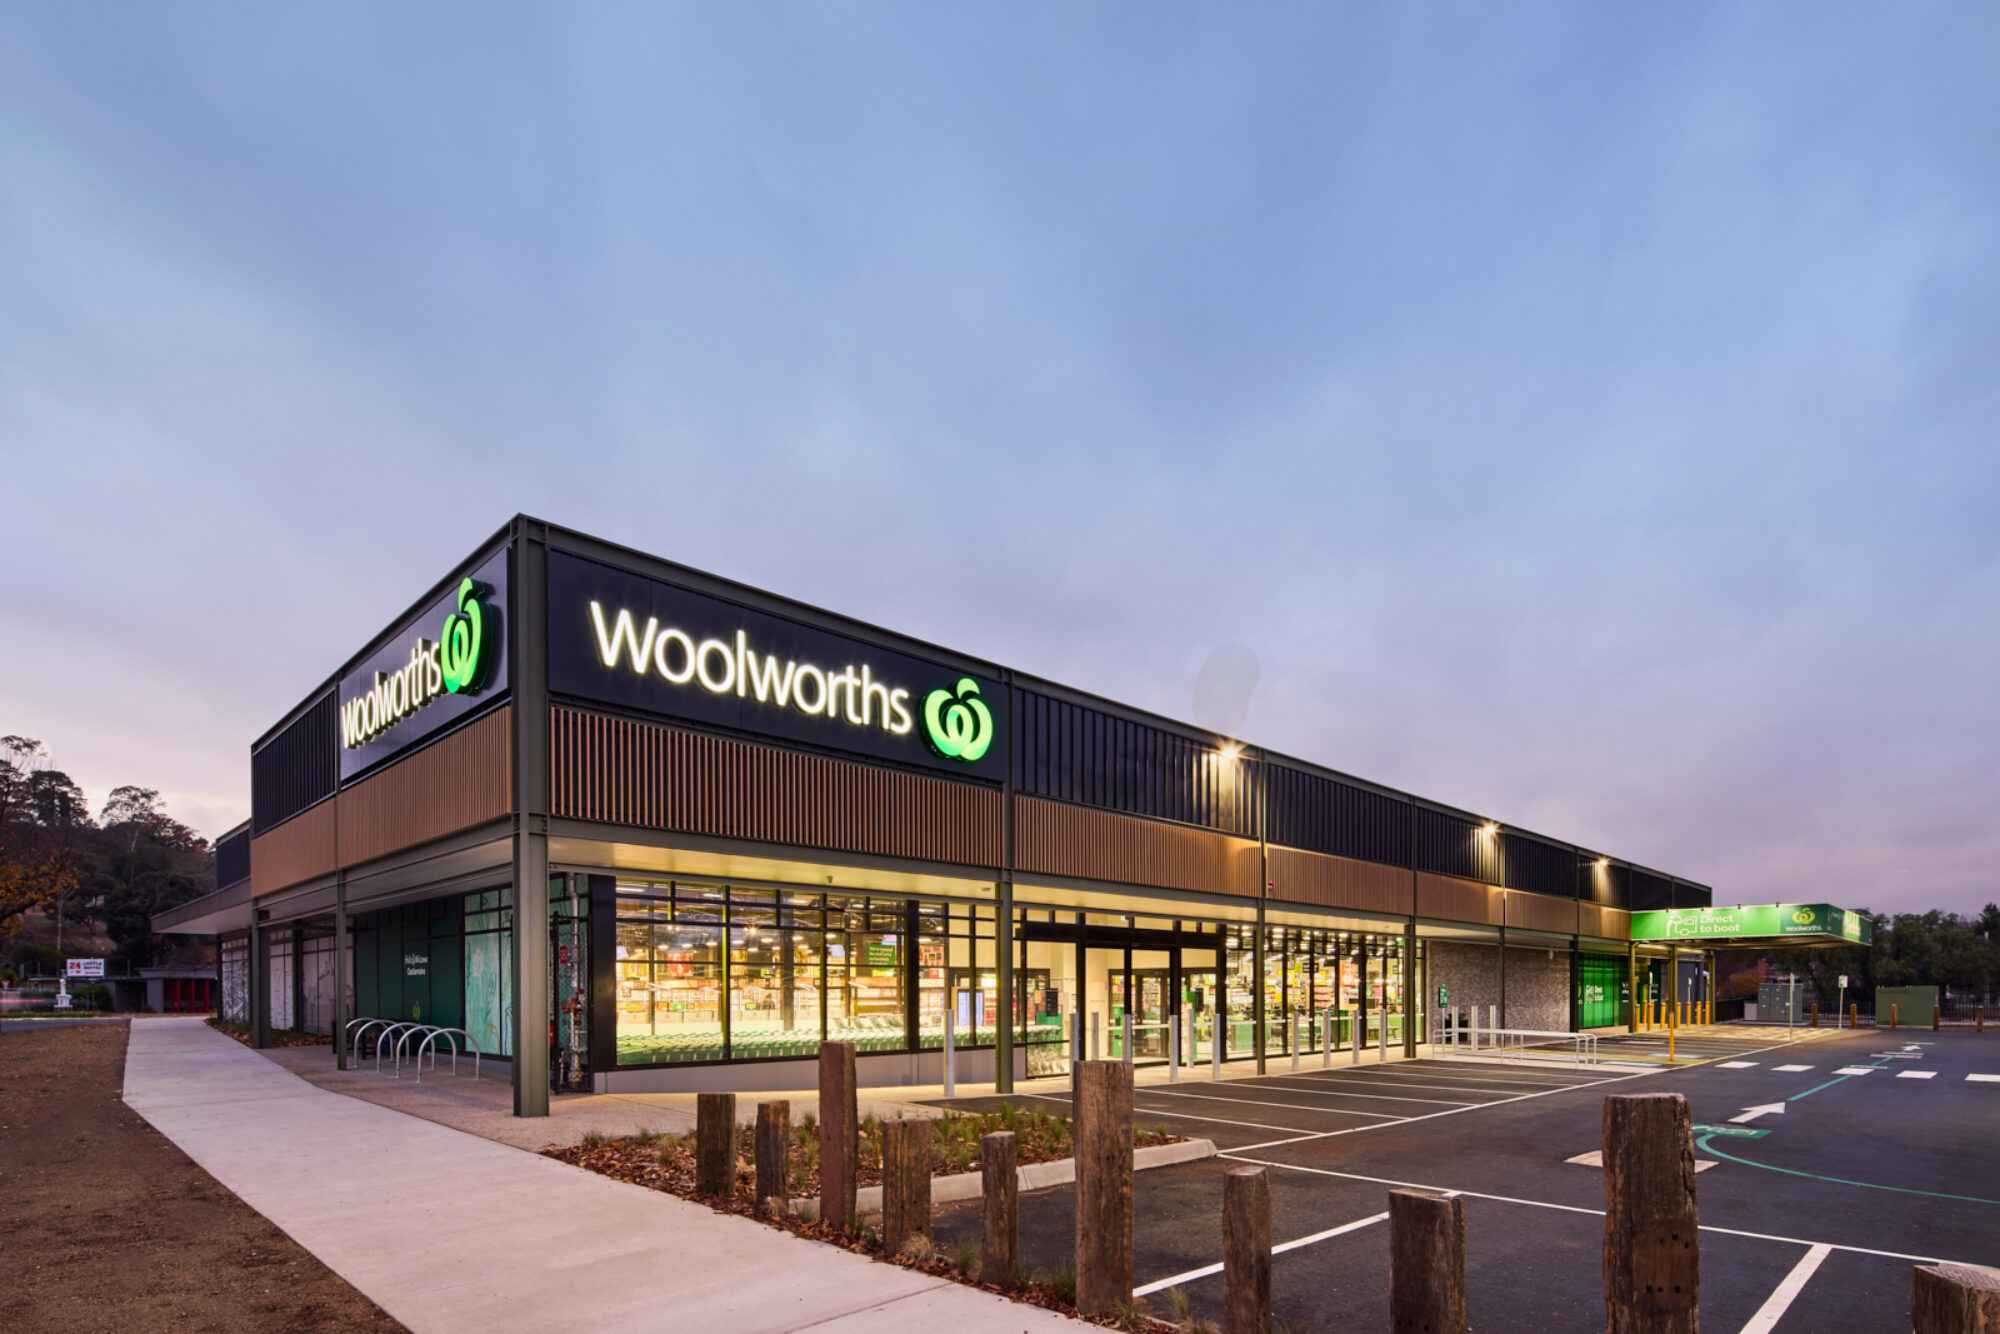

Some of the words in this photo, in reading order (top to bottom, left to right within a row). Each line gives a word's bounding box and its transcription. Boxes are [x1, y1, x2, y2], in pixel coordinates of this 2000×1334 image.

[341, 637, 442, 749] Woolworths
[589, 600, 913, 735] Woolworths
[1700, 914, 1734, 924] Direct
[1700, 925, 1712, 933] to
[1713, 924, 1741, 933] boot
